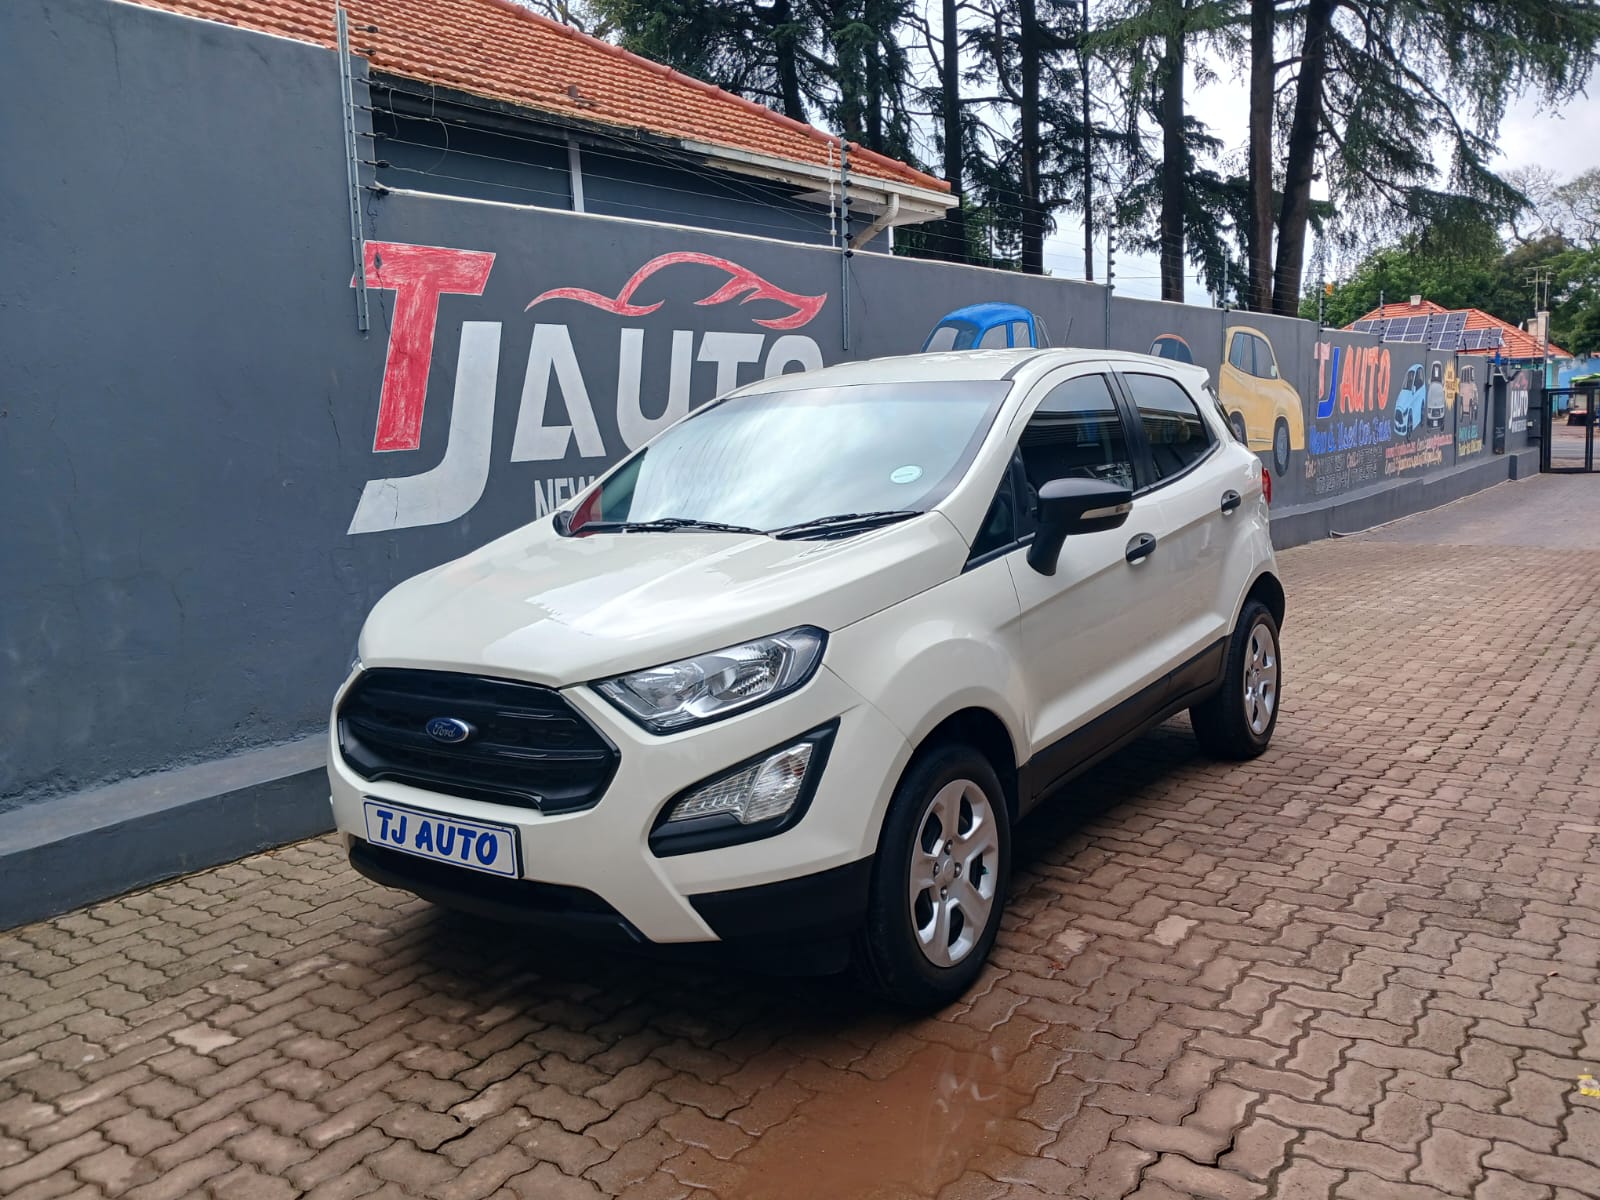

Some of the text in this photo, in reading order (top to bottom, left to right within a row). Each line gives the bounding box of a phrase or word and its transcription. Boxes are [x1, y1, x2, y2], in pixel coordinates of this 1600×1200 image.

[347, 240, 502, 535] TJ
[1314, 342, 1391, 420] TJ AUTO
[432, 722, 456, 738] Ford
[377, 809, 498, 866] TJ AUTO
